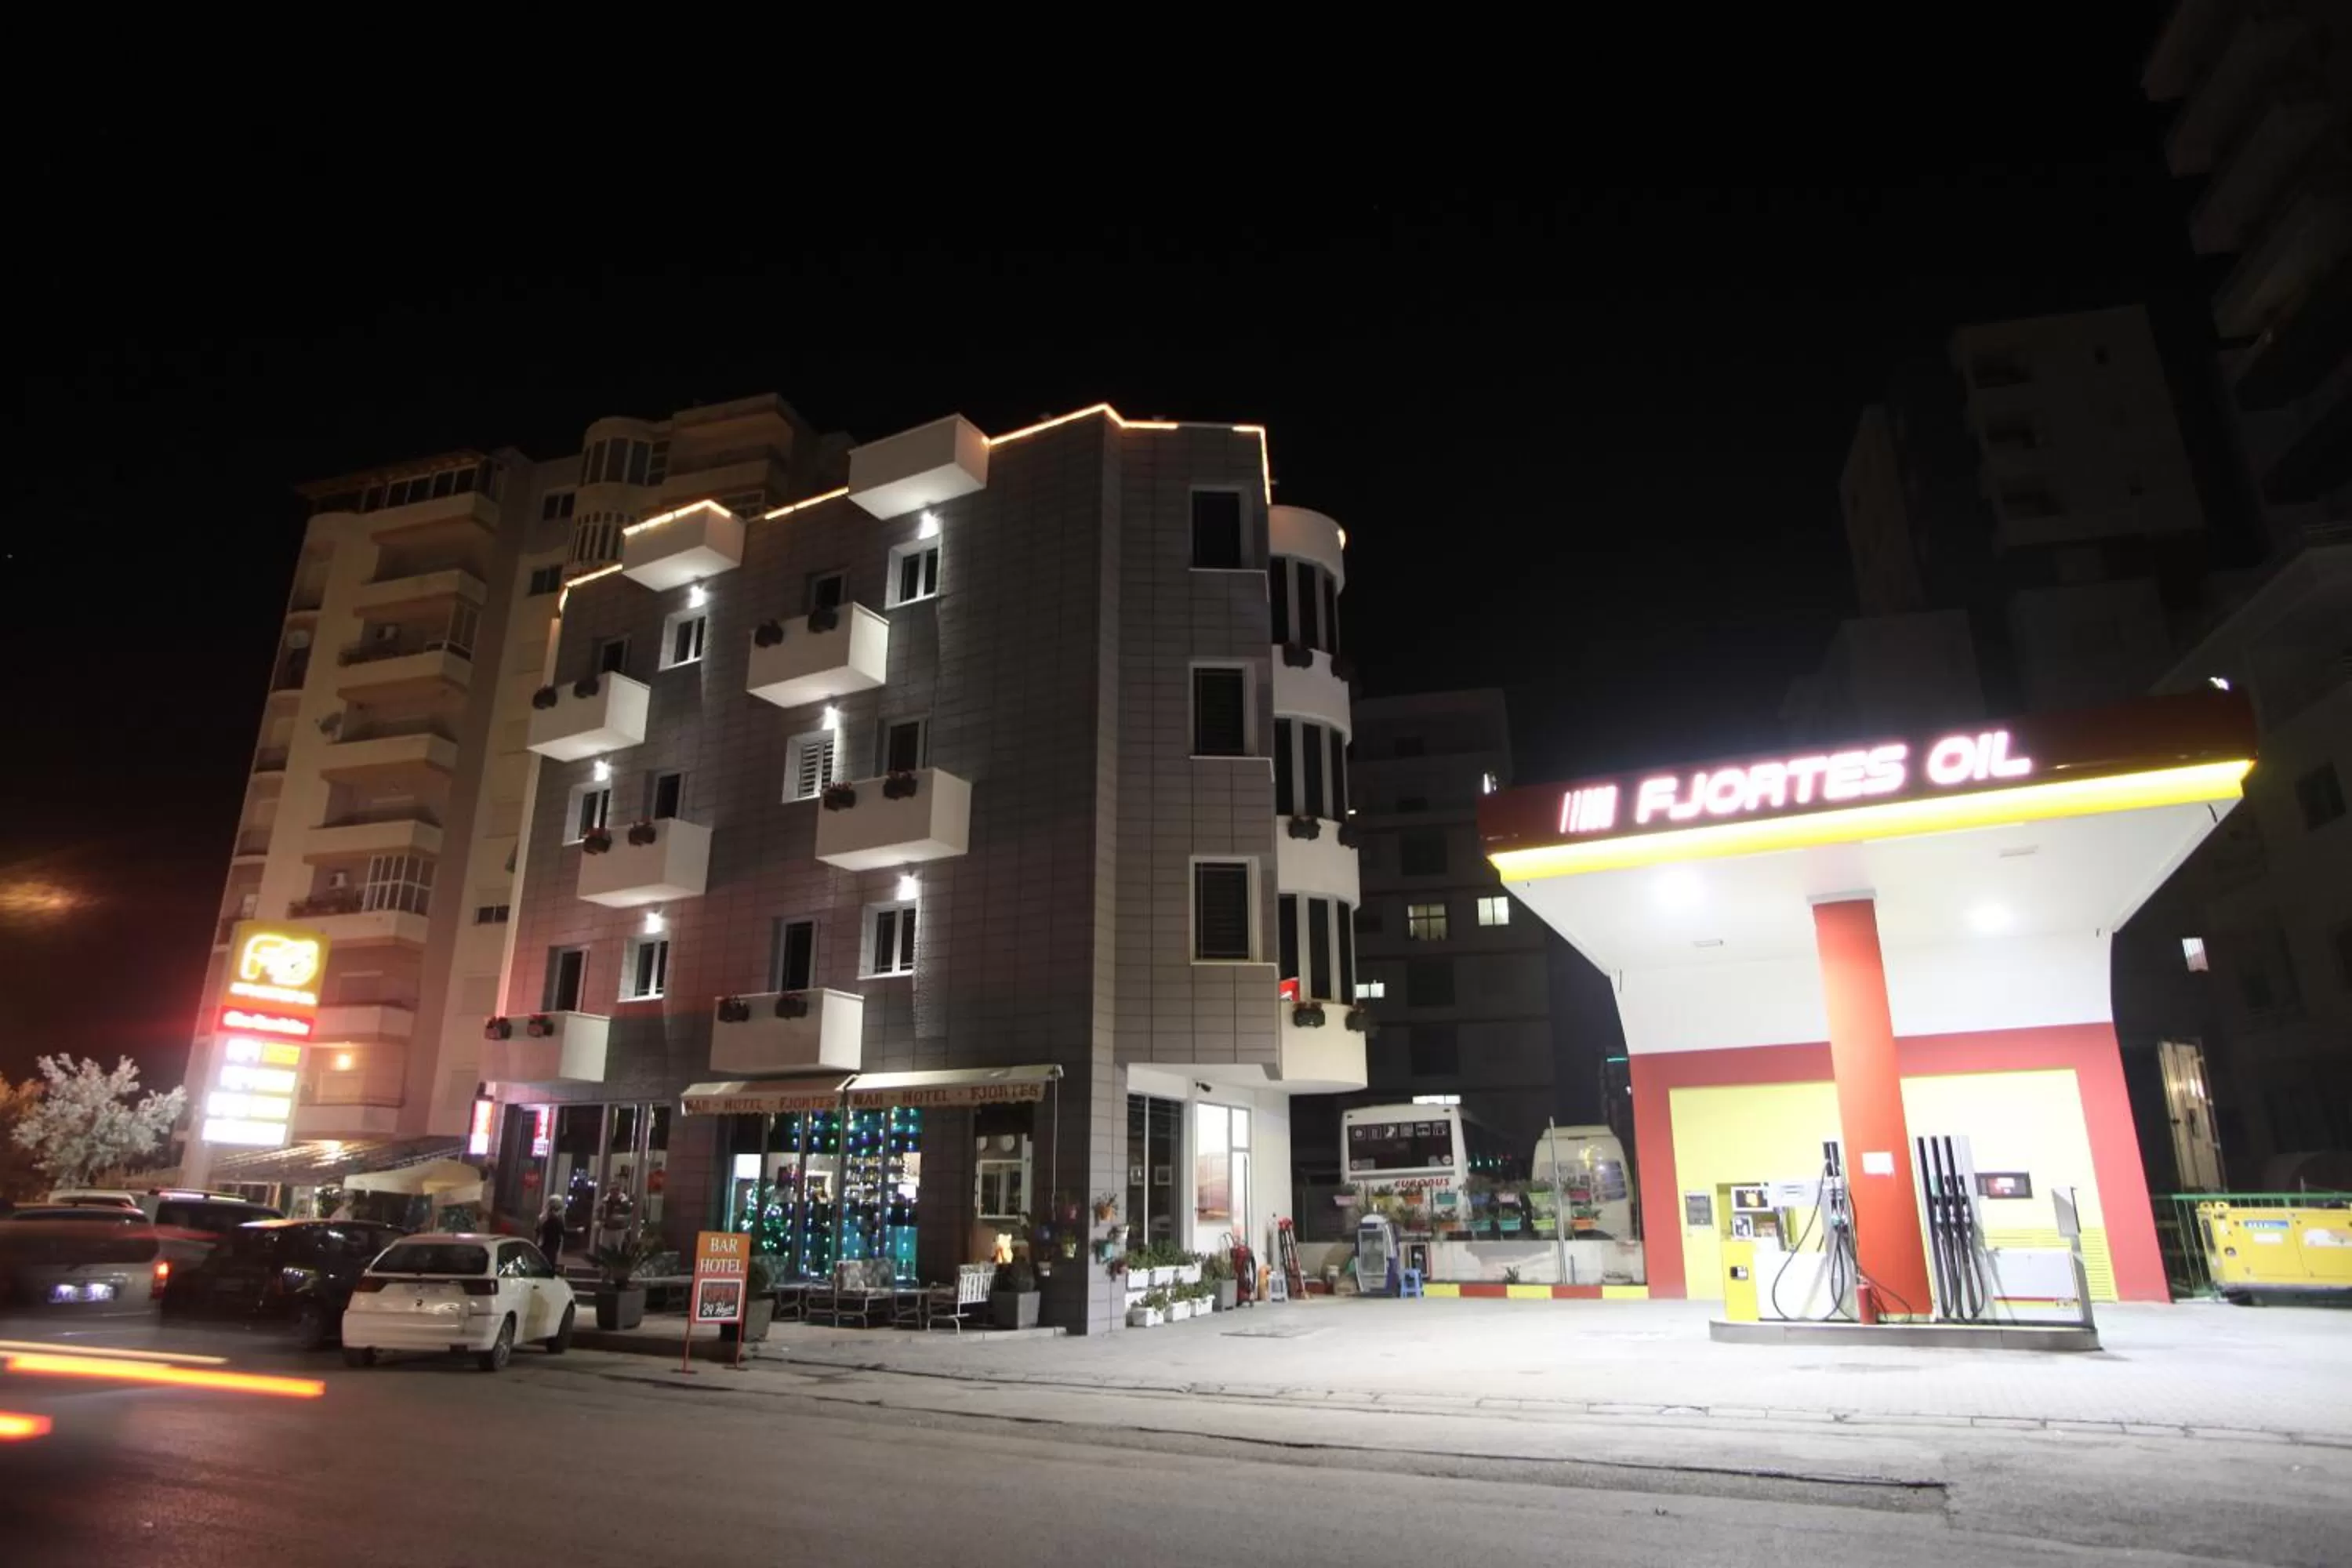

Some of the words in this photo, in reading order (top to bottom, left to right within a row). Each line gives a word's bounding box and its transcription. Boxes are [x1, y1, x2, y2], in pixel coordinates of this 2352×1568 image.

[1636, 744, 1908, 824] FJORTES
[1926, 731, 2032, 785] OIL
[724, 1098, 764, 1110] HOTEL
[853, 1092, 884, 1106] BAR
[902, 1090, 949, 1104] HOTEL
[710, 1237, 738, 1253] BAR
[700, 1258, 744, 1274] HOTEL
